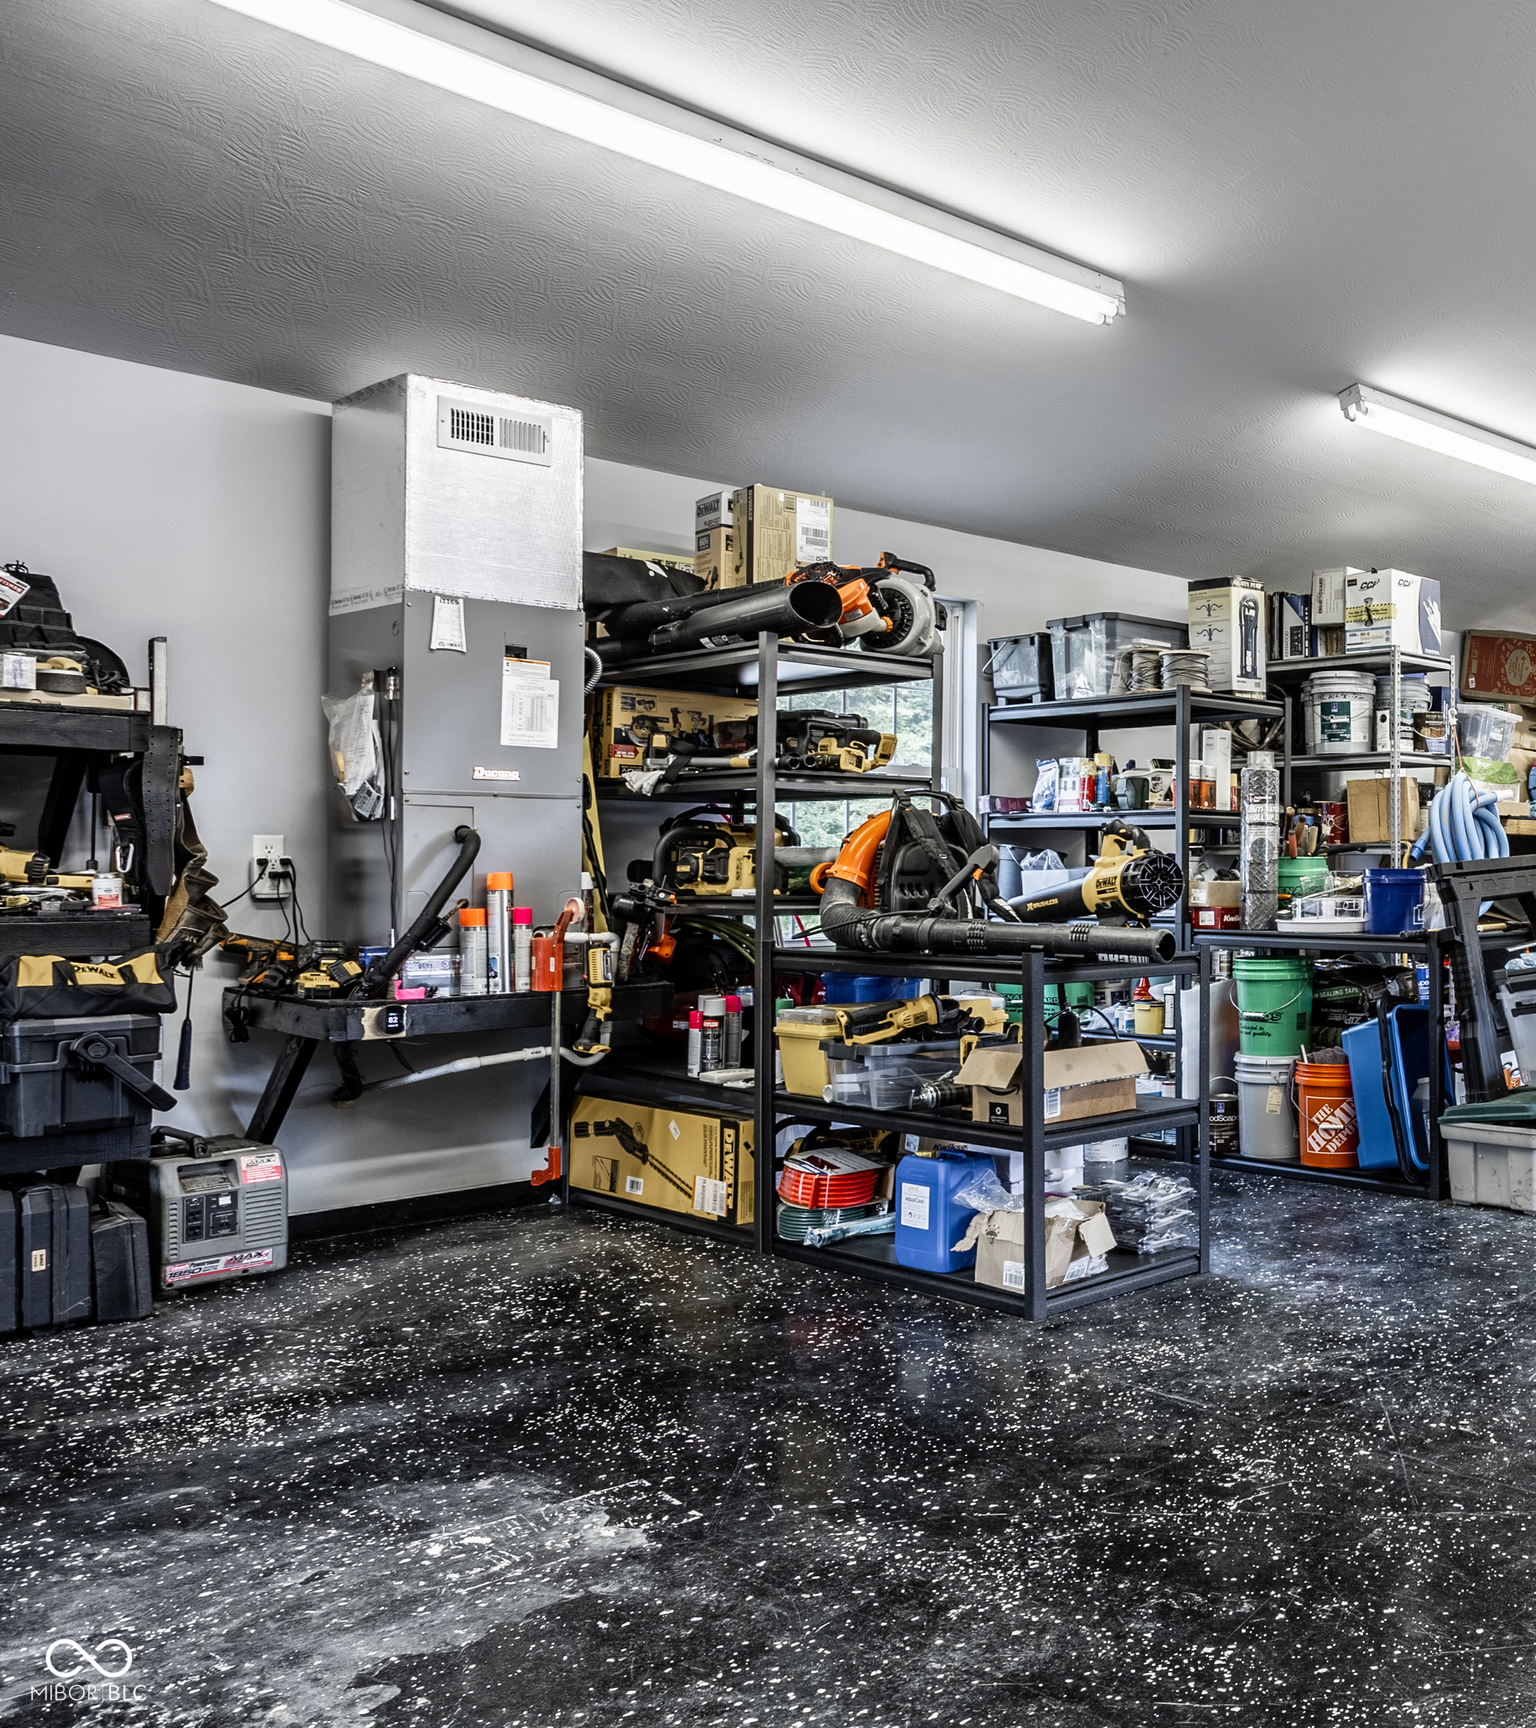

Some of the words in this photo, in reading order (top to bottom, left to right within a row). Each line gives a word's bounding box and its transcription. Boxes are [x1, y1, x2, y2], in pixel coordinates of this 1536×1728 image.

[1319, 988, 1344, 998] SEALING
[1344, 986, 1359, 994] TAPE
[1307, 1101, 1357, 1153] HOM
[1311, 1104, 1334, 1125] THE
[1326, 1121, 1357, 1154] DEPO
